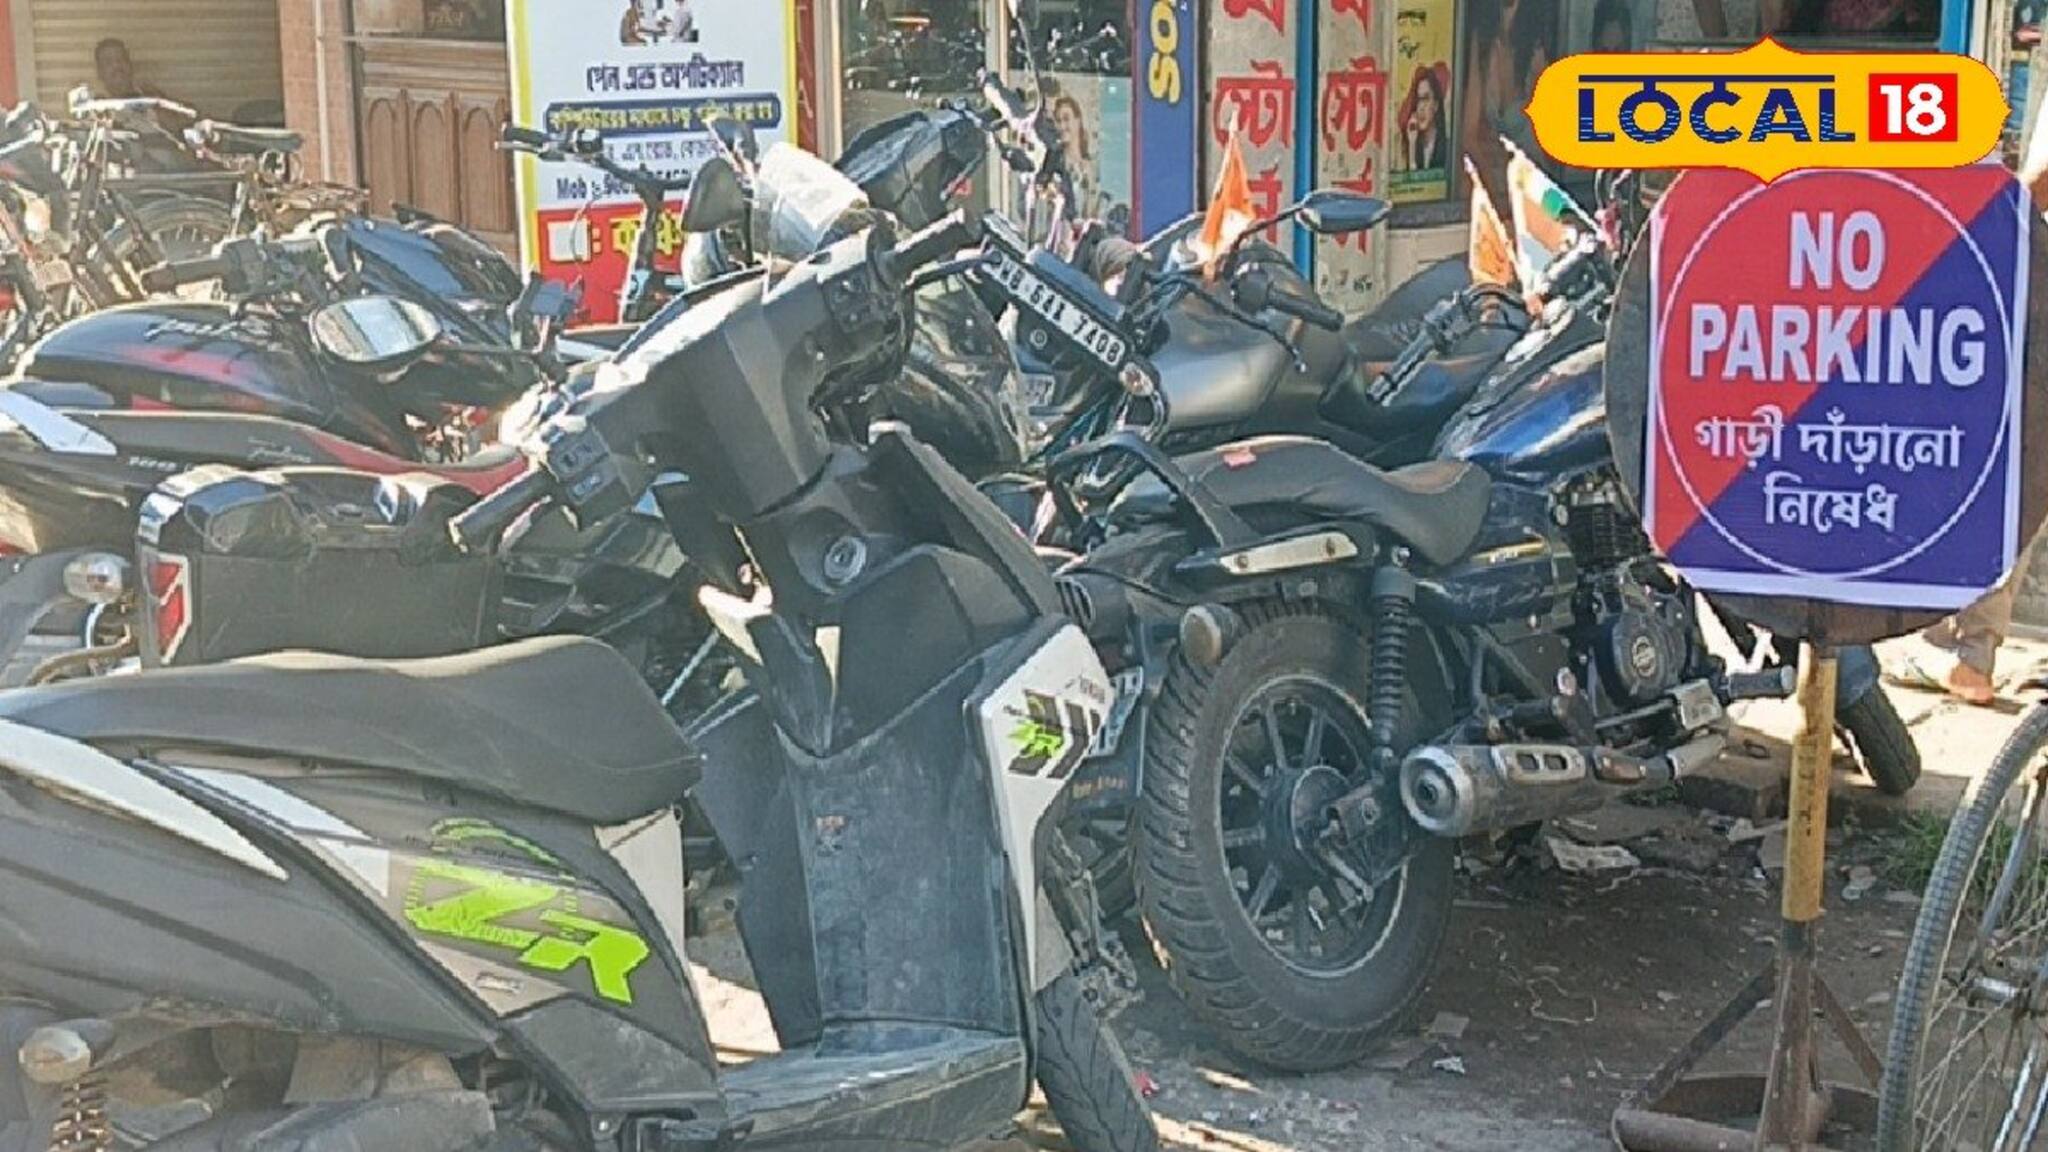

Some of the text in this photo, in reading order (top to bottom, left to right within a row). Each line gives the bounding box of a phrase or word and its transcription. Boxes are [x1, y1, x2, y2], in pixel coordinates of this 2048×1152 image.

[1148, 0, 1180, 103] SO
[1788, 210, 1886, 291] NO
[1688, 304, 1986, 387] PARKING
[1694, 405, 1967, 474] গাড়ী দাঁড়ানো
[1763, 471, 1899, 533] নিষেধ
